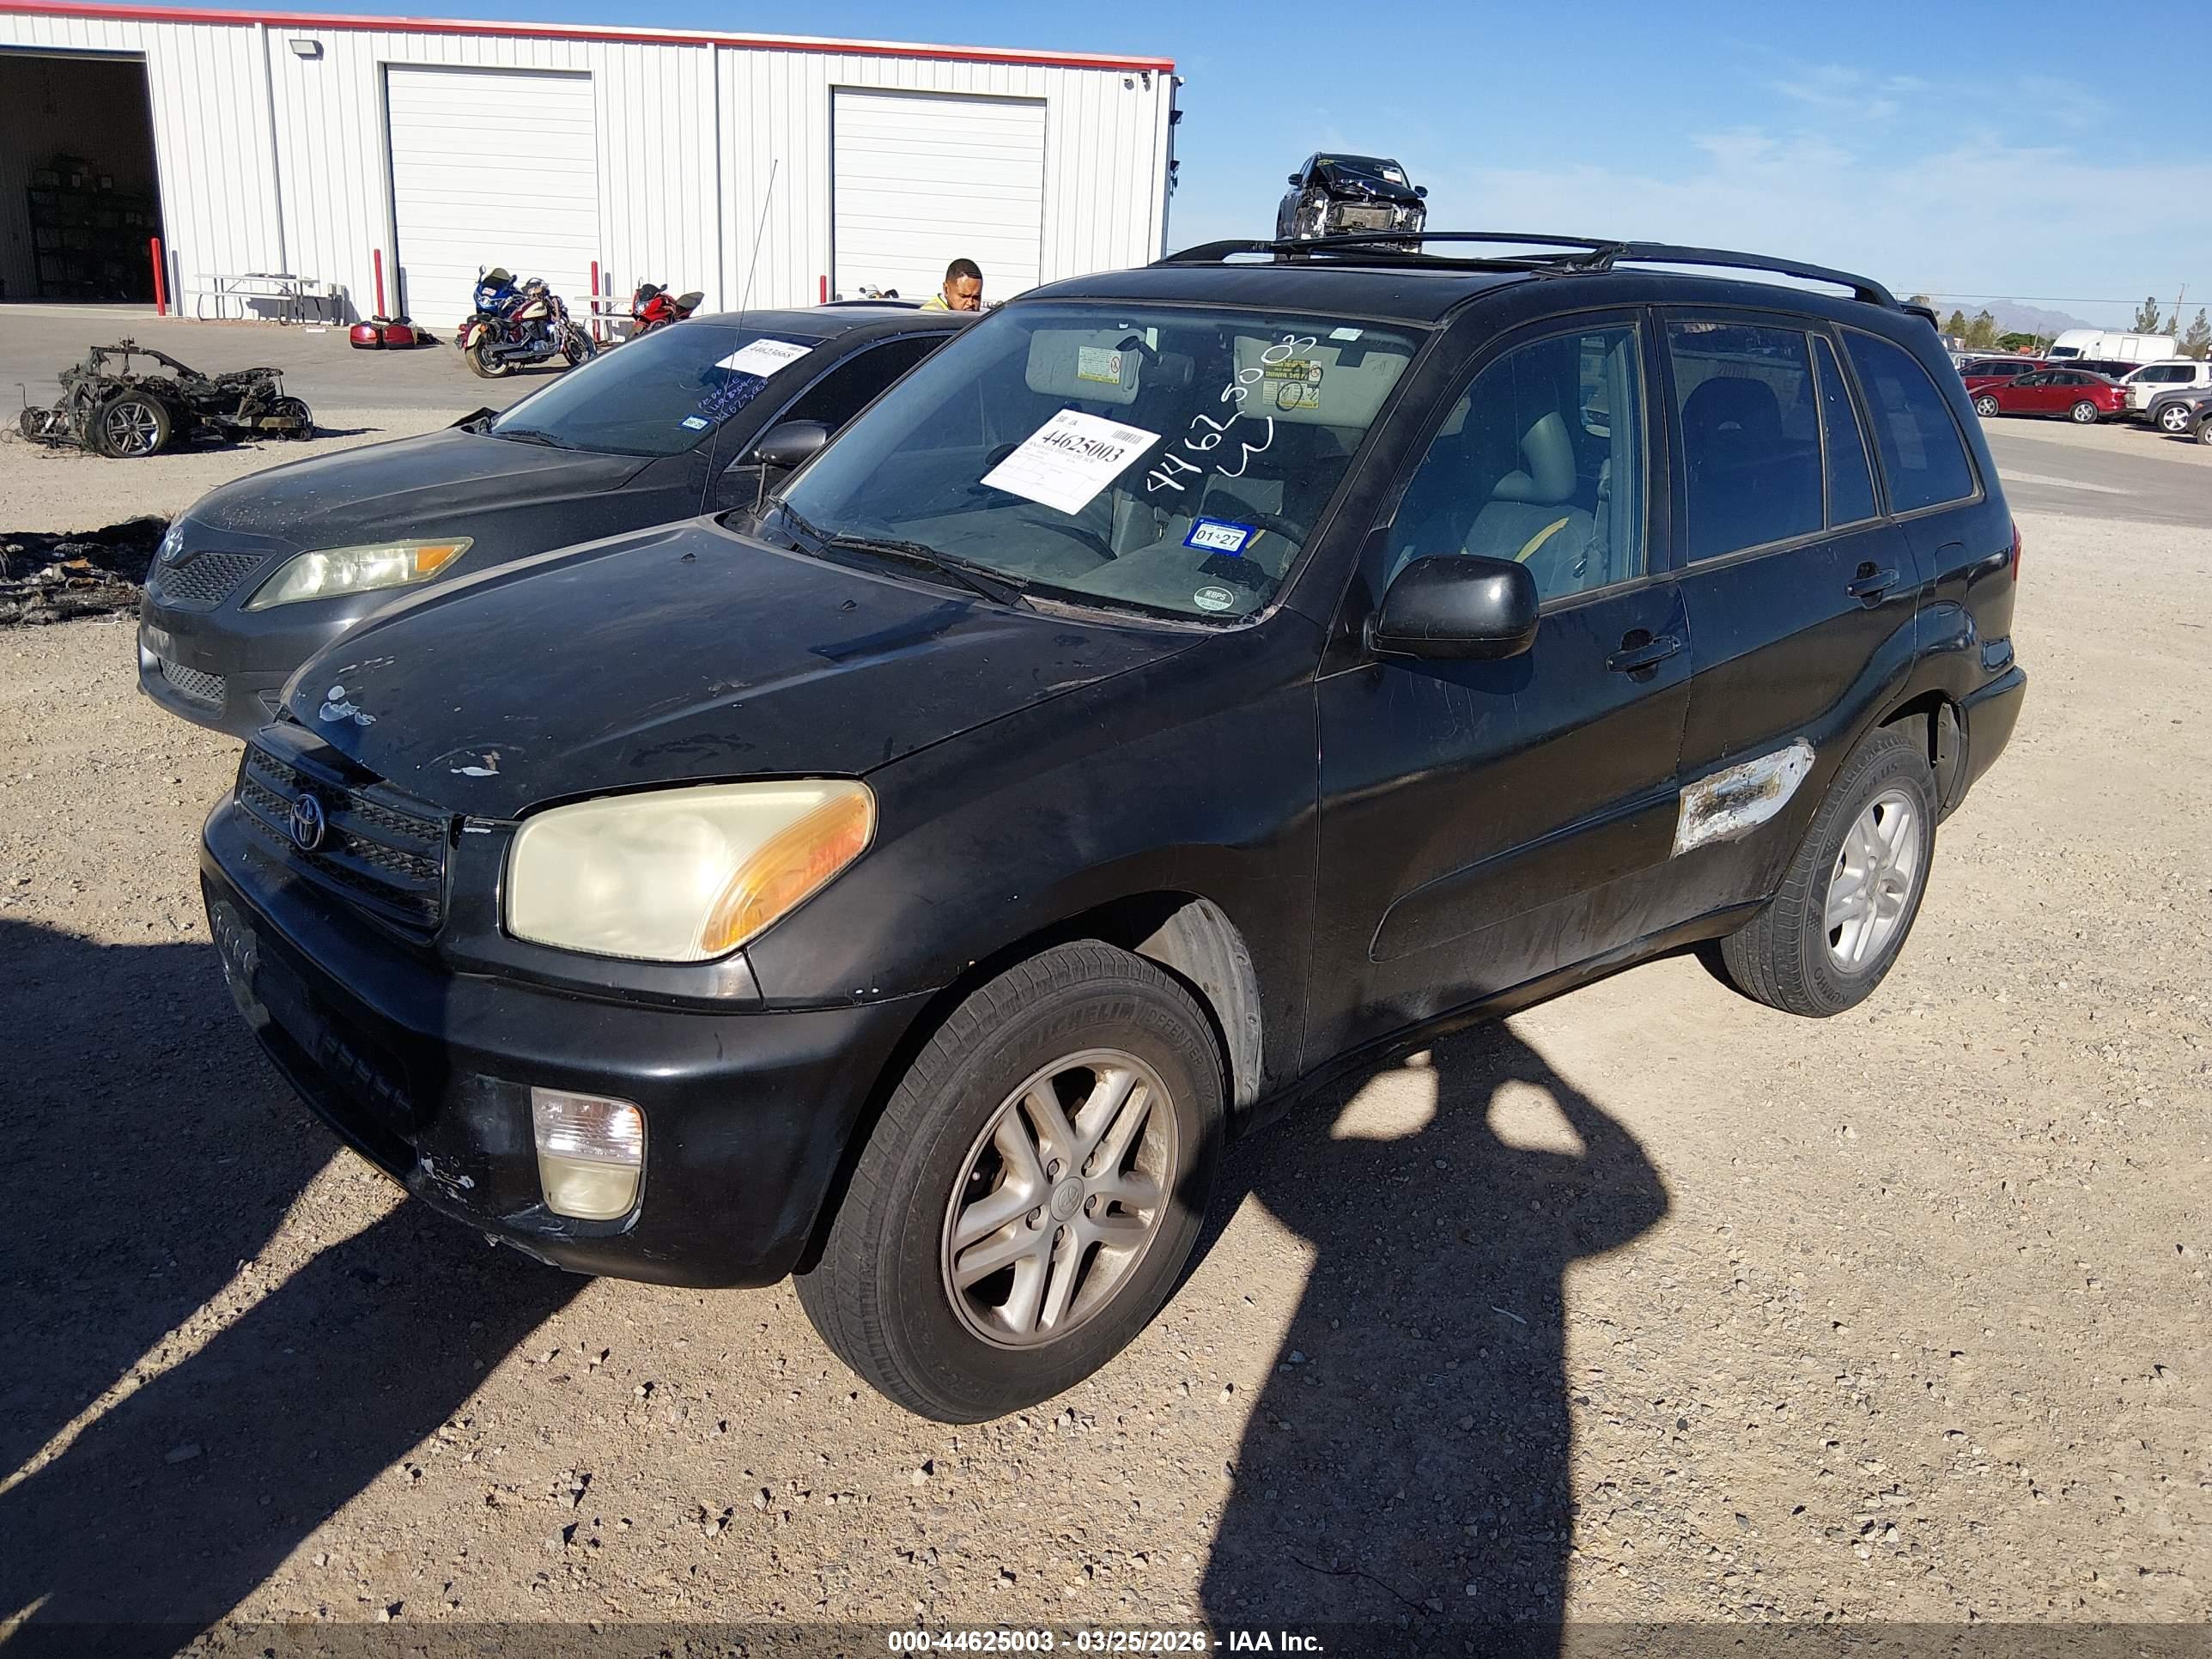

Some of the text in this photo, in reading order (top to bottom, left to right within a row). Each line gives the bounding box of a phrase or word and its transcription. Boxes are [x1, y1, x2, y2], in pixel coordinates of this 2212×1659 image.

[1042, 429, 1125, 462] 44625003
[1814, 967, 1848, 1005] KUMHO
[1146, 1009, 1204, 1066] DEFENDER
